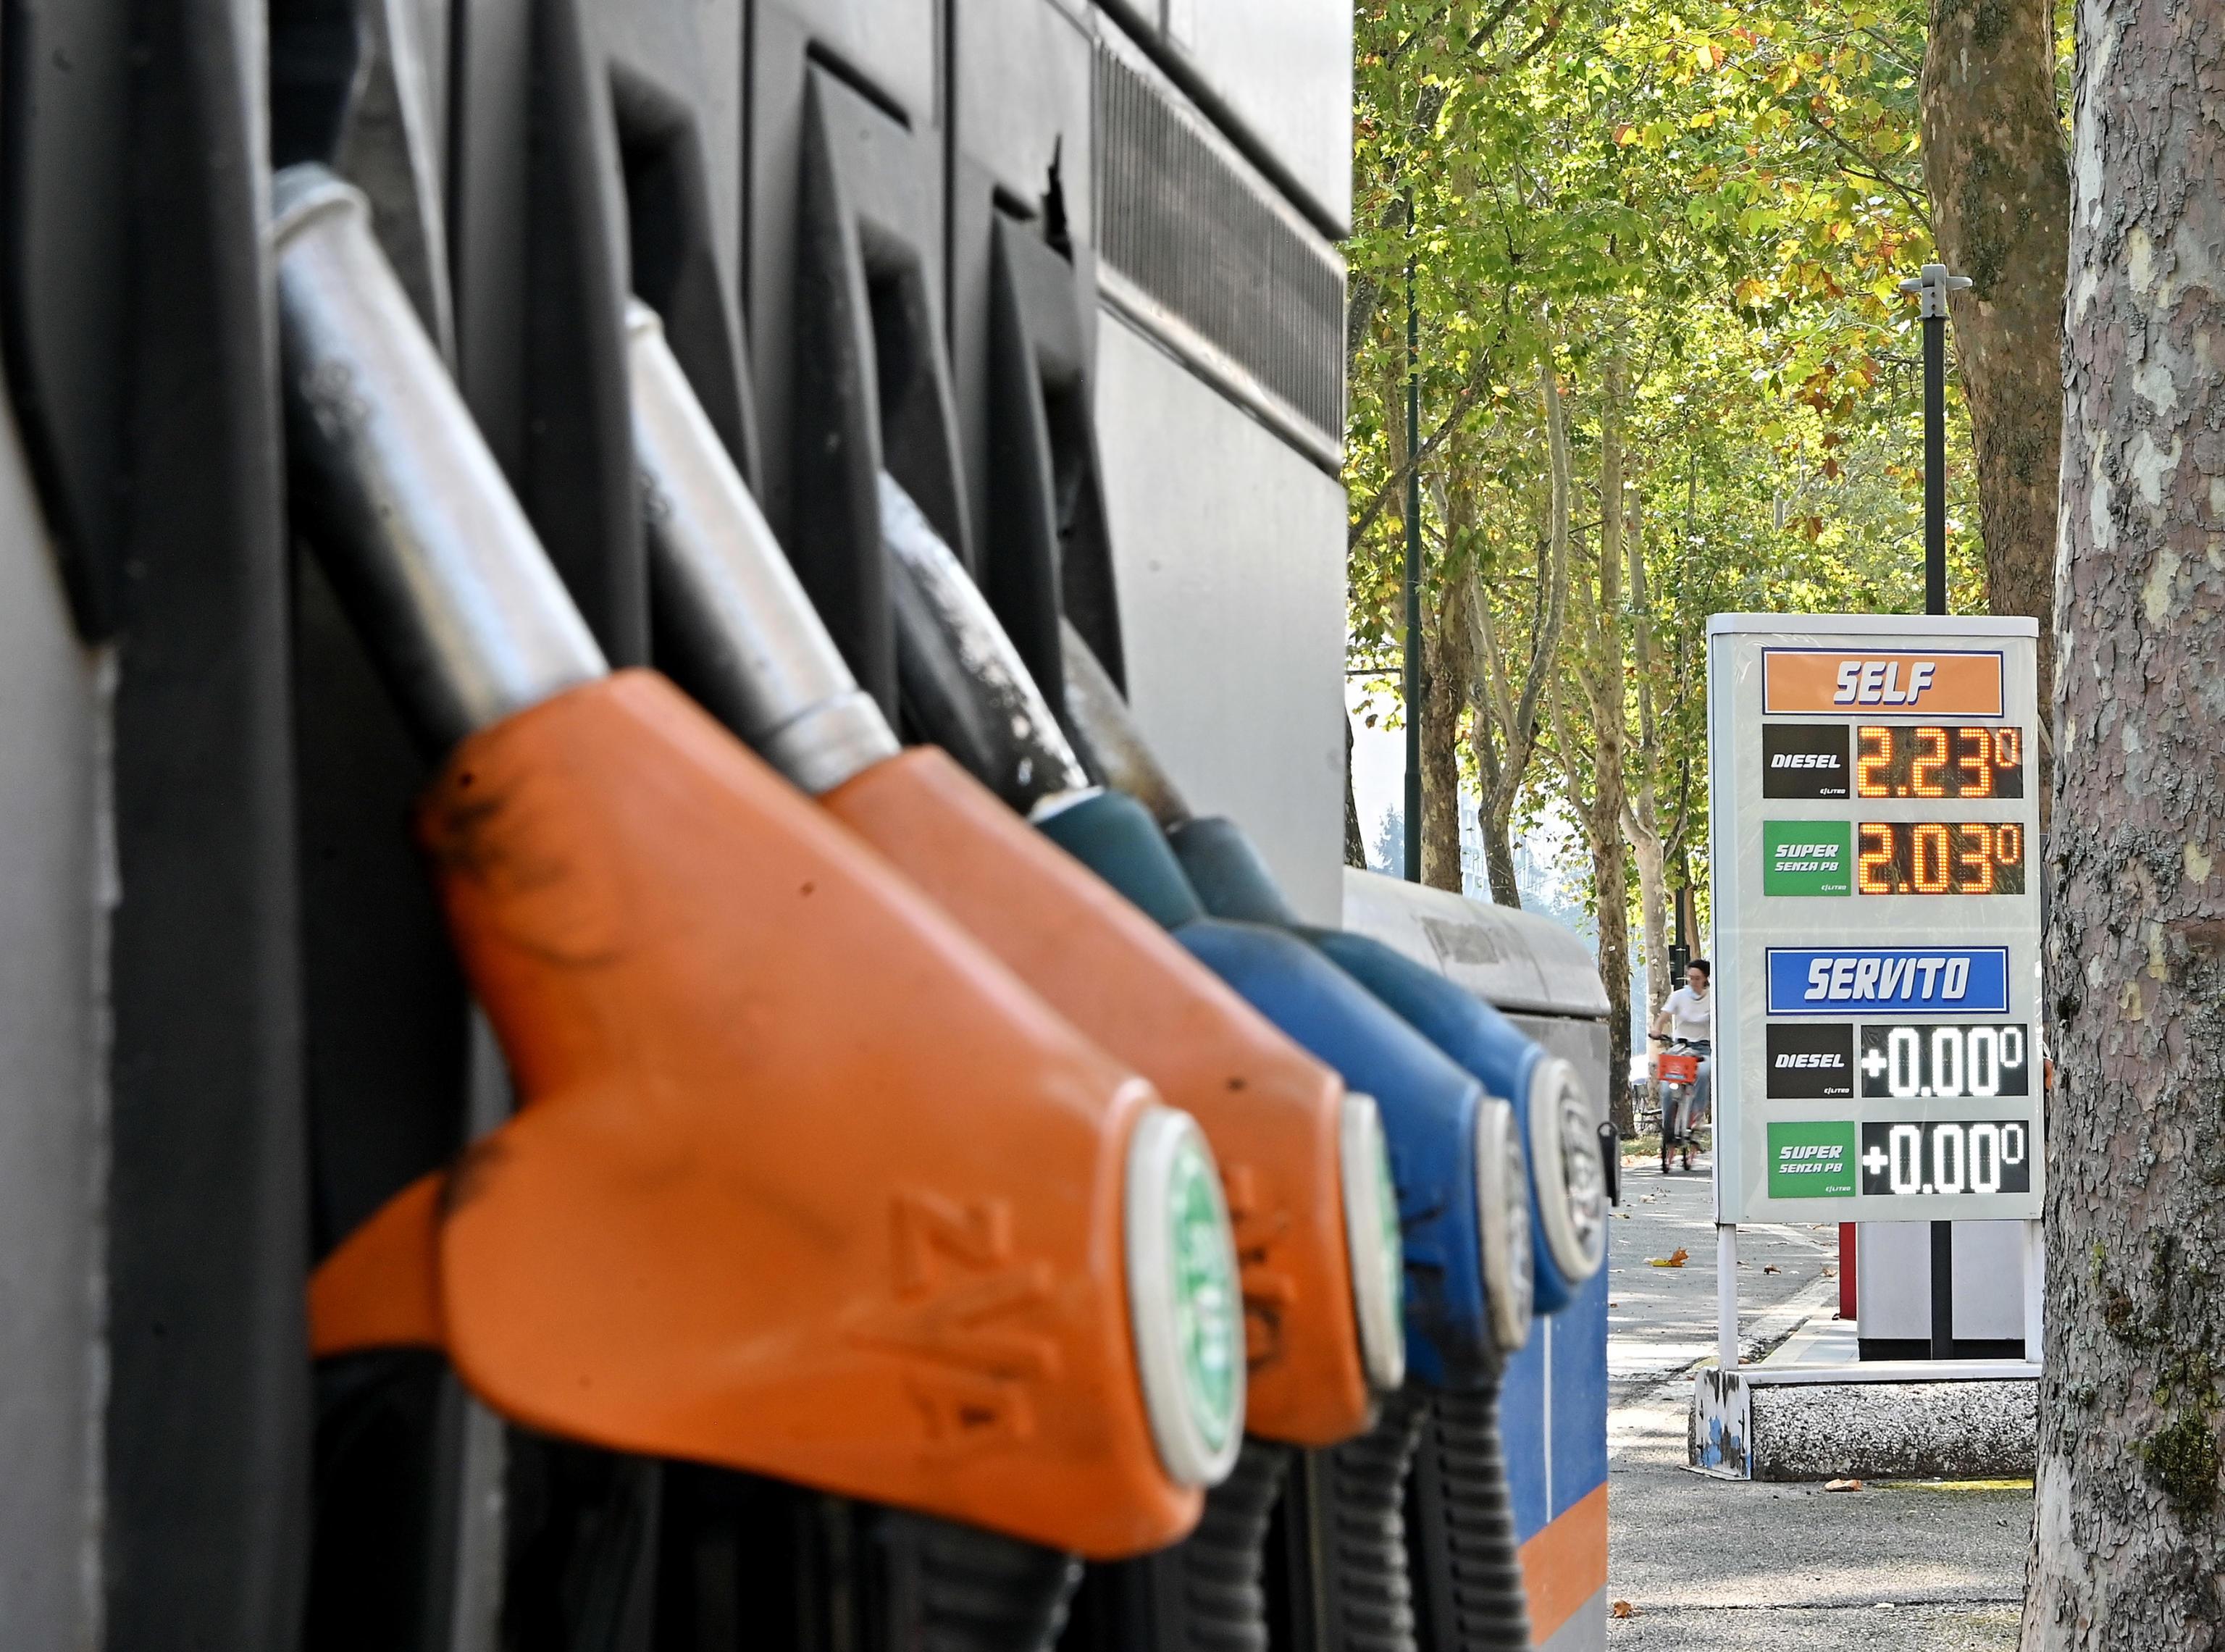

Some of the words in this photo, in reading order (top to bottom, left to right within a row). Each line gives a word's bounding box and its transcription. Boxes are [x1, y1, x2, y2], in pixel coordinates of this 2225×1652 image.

[1833, 661, 1935, 704] SELF
[1771, 754, 1841, 769] DIESEL
[1774, 844, 1839, 858] SUPER
[1774, 862, 1819, 872] SENZA
[1820, 862, 1839, 872] PB
[1804, 957, 1971, 1001] SERVITO
[1774, 1054, 1845, 1068] DIESEL
[1779, 1146, 1843, 1160] SUPER
[1779, 1164, 1822, 1174] SENZA
[1824, 1163, 1843, 1173] PB
